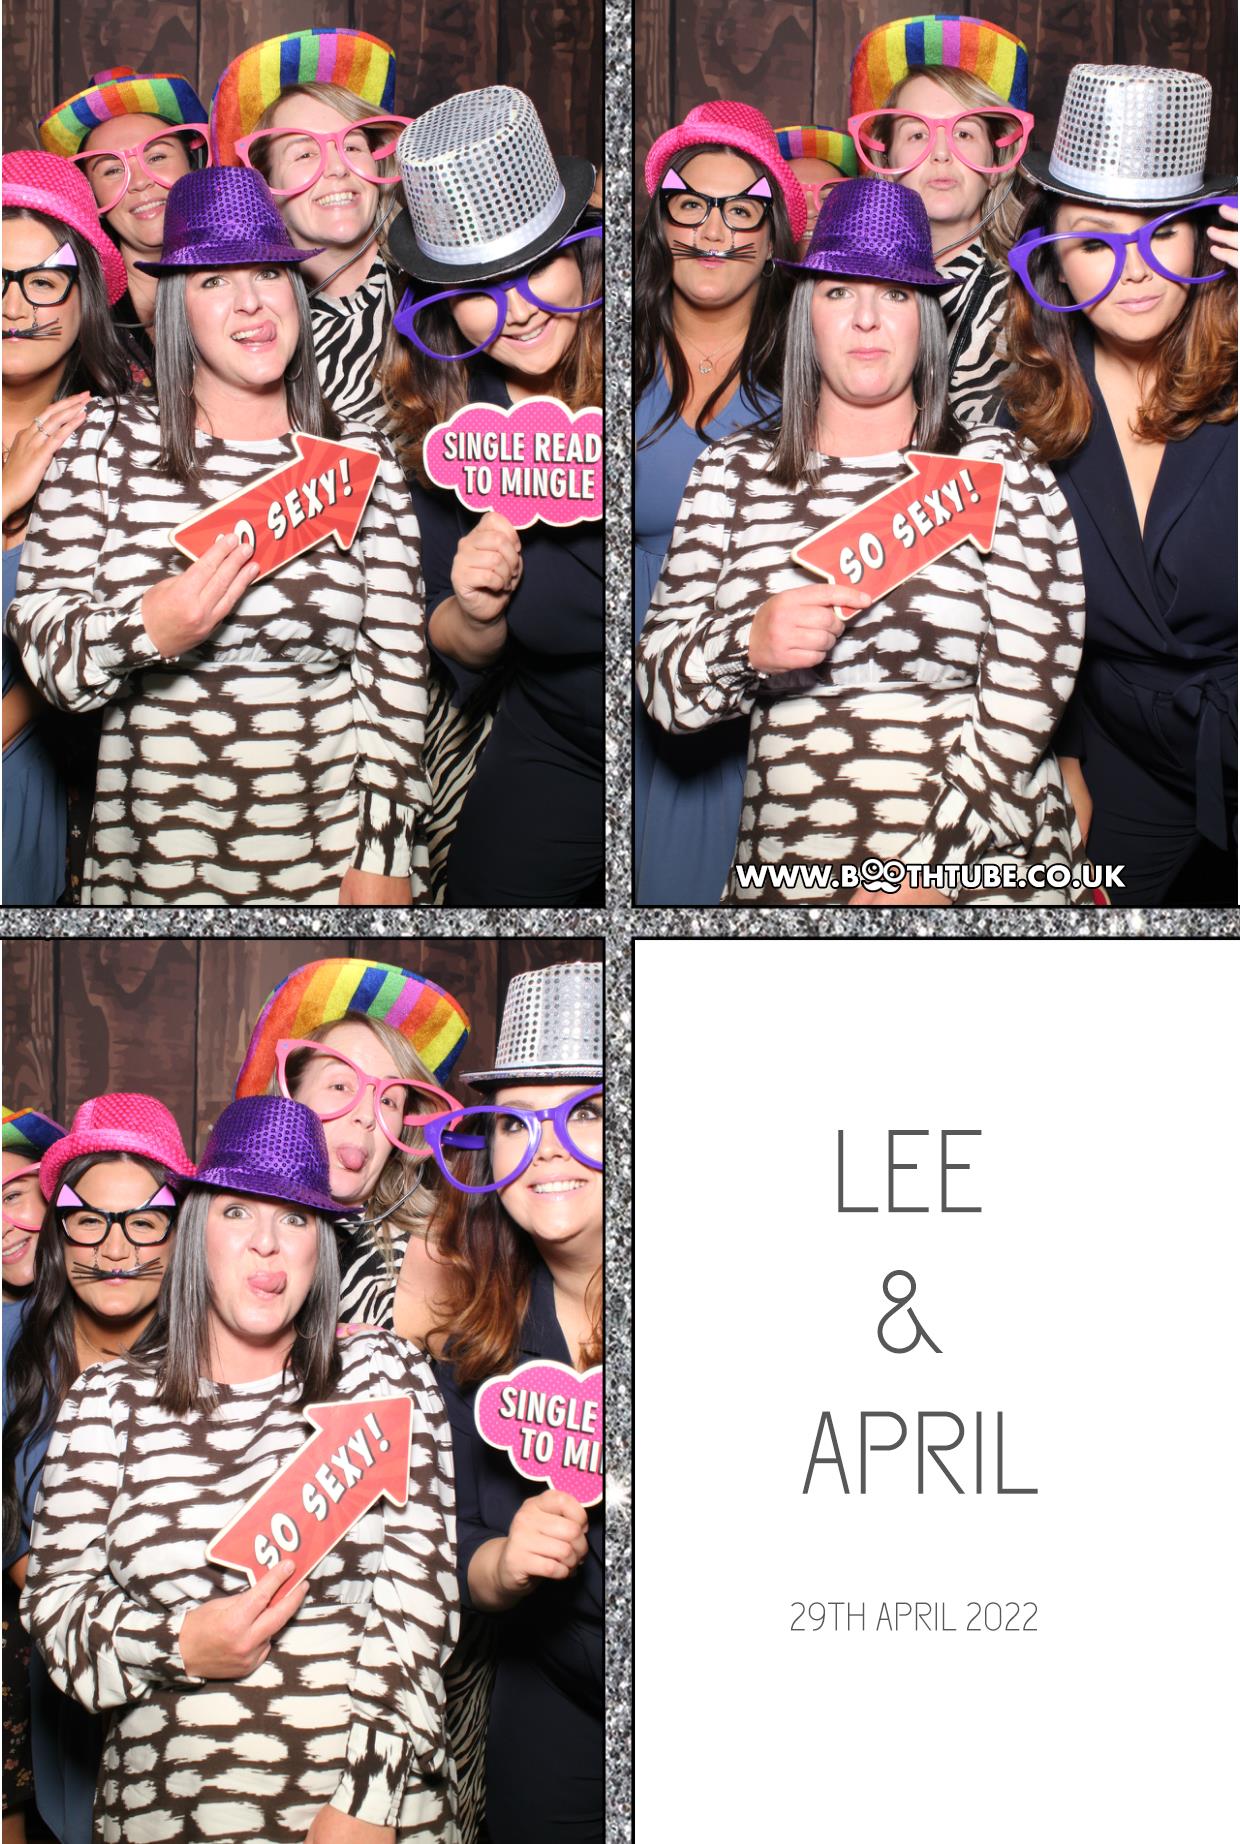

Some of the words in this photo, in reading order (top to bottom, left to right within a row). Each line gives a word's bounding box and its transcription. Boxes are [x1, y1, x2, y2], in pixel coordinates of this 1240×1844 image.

[443, 431, 525, 462] SINGLE
[464, 466, 492, 495] TO
[499, 466, 595, 501] MINGLE
[214, 518, 256, 559] O
[267, 458, 354, 541] SEXY!
[839, 532, 885, 584] SO
[892, 469, 981, 549] SEXY!
[500, 1387, 598, 1435] SINGLE
[520, 1427, 554, 1464] TO
[562, 1436, 602, 1475] MI
[254, 1513, 300, 1569] SO
[302, 1412, 391, 1521] SEXY!
